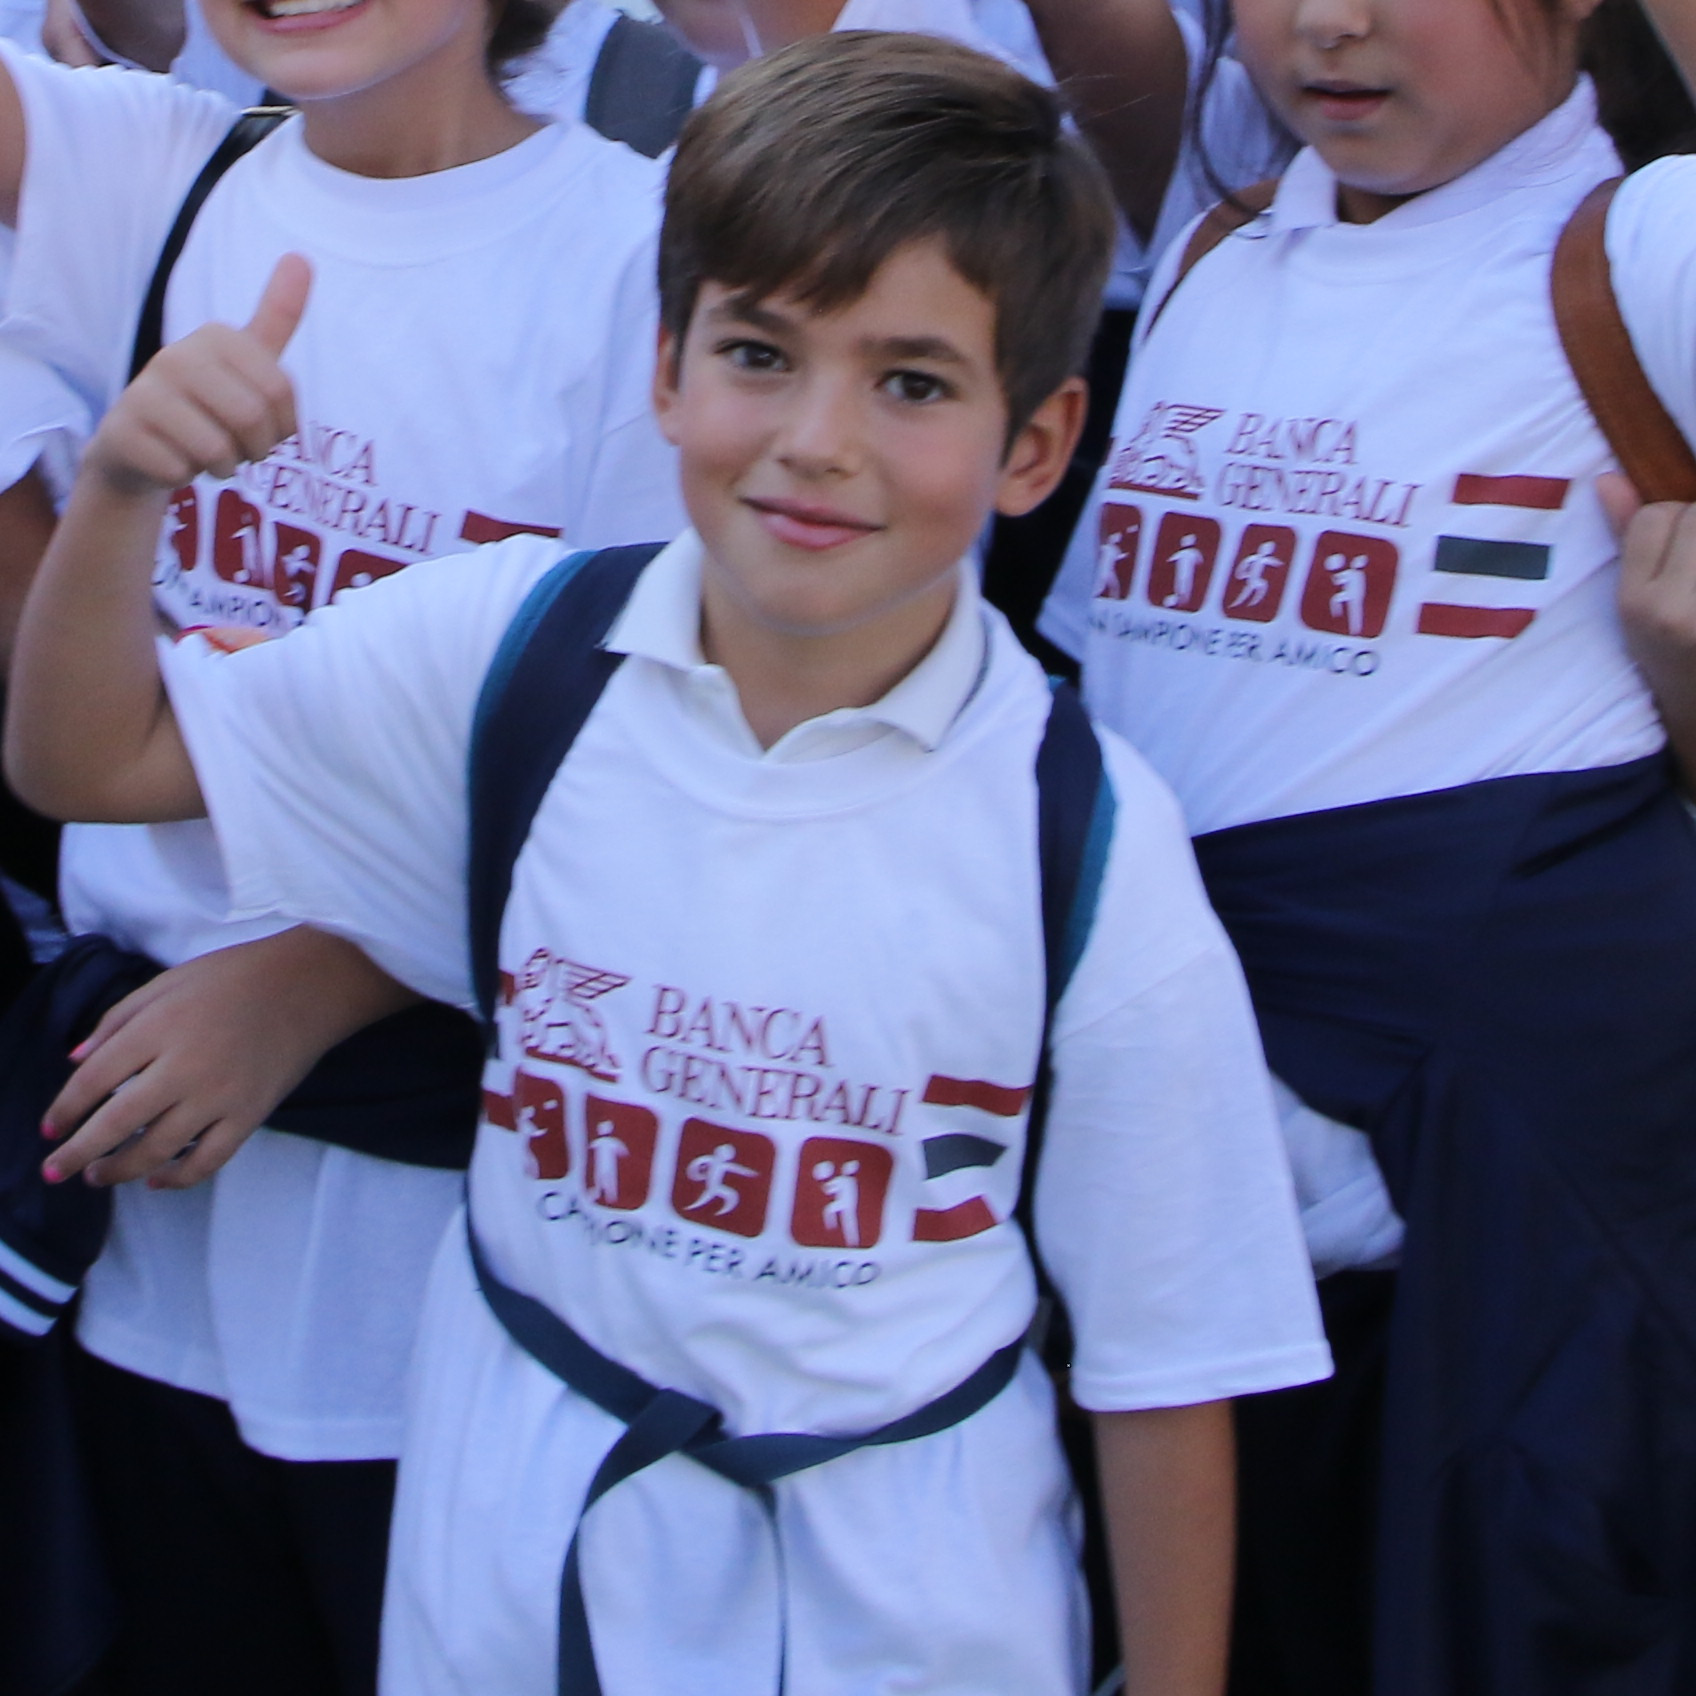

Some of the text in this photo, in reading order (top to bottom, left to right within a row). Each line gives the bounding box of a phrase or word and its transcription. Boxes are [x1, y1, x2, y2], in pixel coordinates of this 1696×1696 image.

[1214, 462, 1425, 529] GENERALI
[645, 984, 834, 1067] BANCA
[640, 1045, 910, 1135] GENERALI
